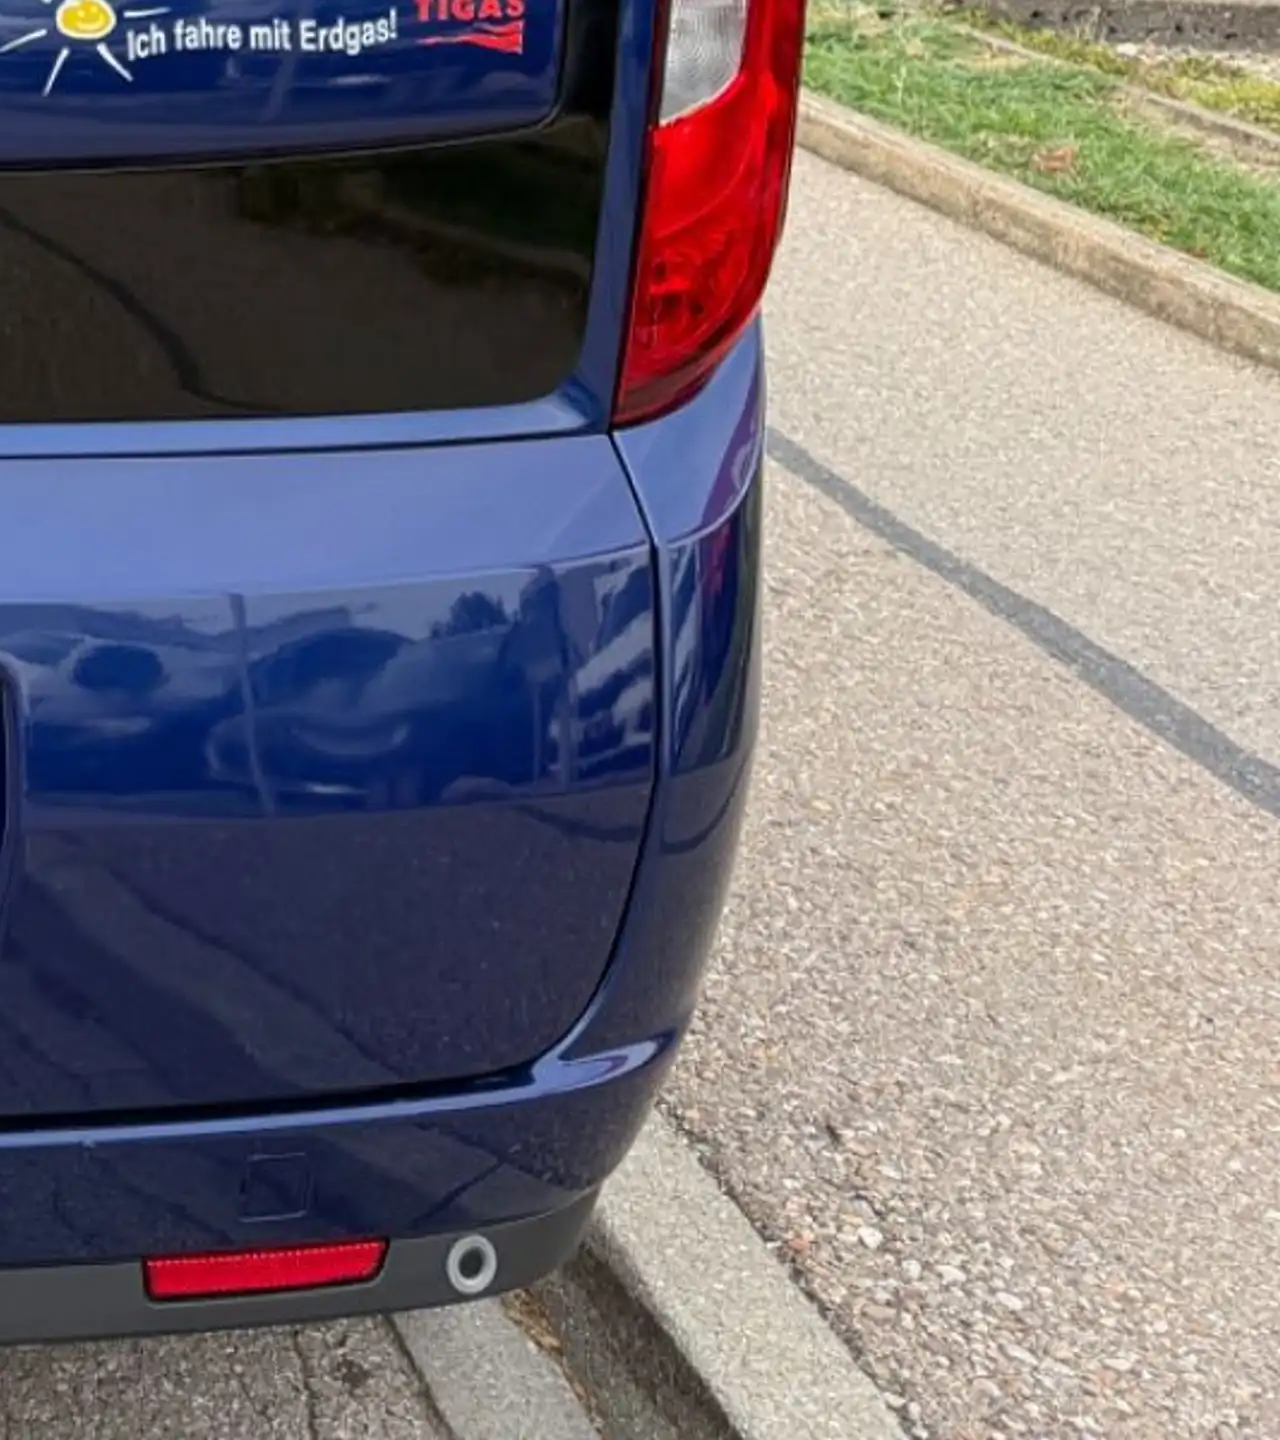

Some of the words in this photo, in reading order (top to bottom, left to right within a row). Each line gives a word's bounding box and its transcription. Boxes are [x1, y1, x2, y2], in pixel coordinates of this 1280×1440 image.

[126, 19, 167, 61] Ich
[173, 19, 241, 51] fahre
[249, 16, 291, 51] mit
[299, 8, 398, 56] Erdgas!
